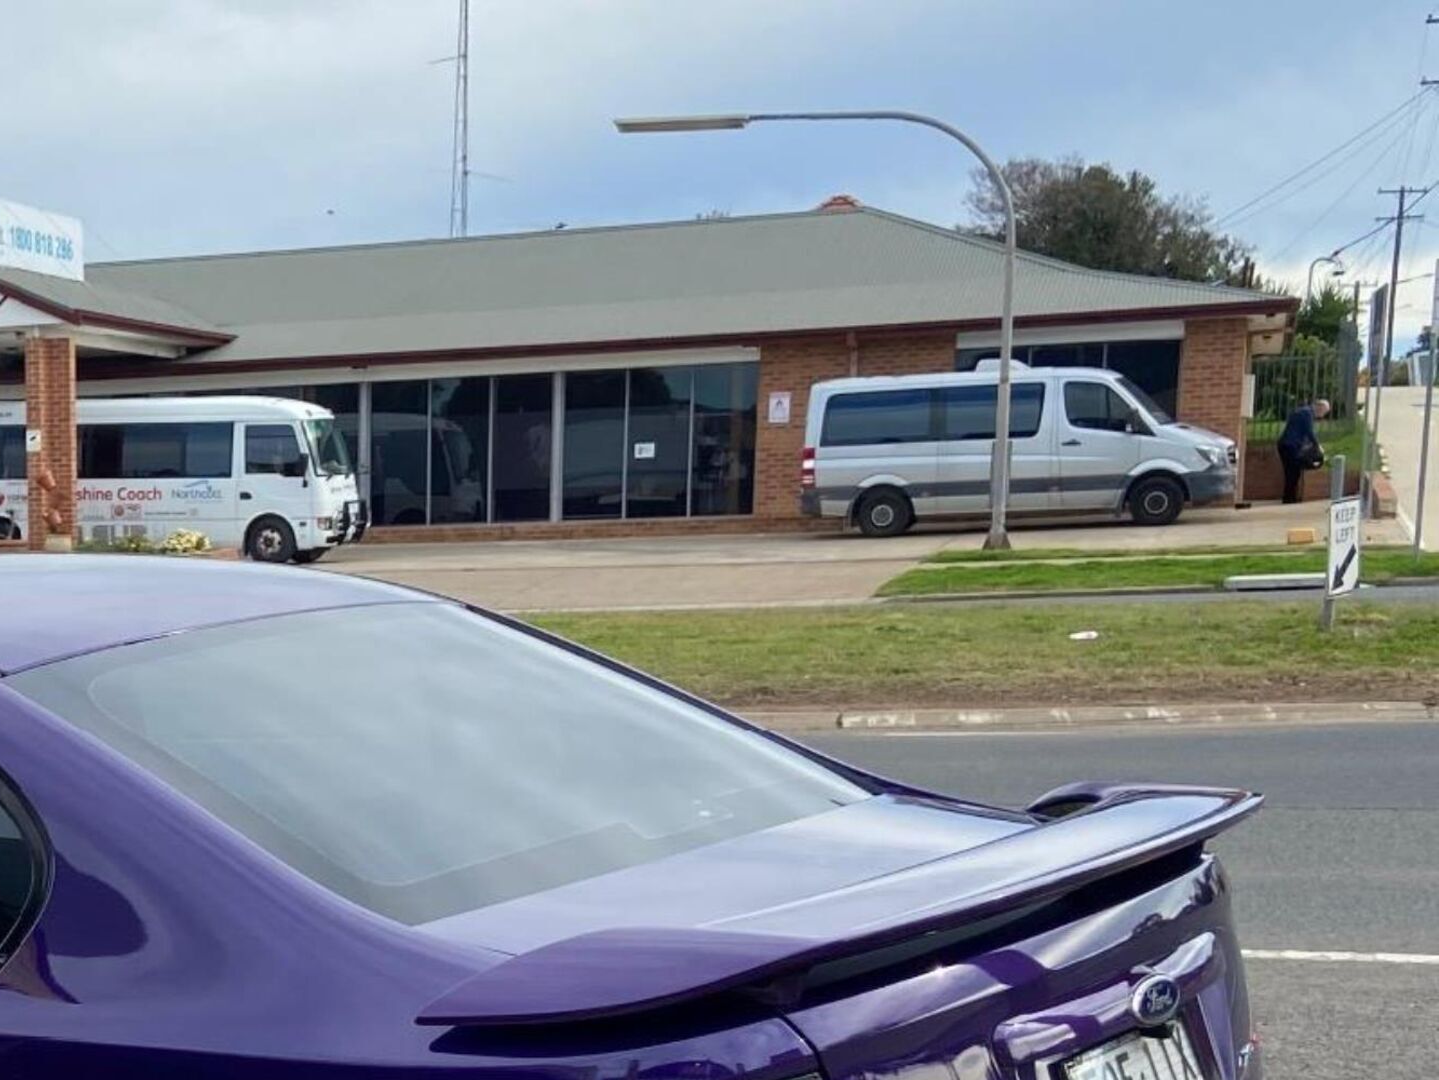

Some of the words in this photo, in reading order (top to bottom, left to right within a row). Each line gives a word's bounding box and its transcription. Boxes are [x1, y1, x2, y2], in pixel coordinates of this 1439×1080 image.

[9, 225, 32, 253] 1800
[34, 231, 54, 256] 818
[75, 486, 113, 501] shine
[117, 486, 162, 501] Coach
[1335, 507, 1357, 523] KEEP
[1335, 525, 1356, 543] LEFT
